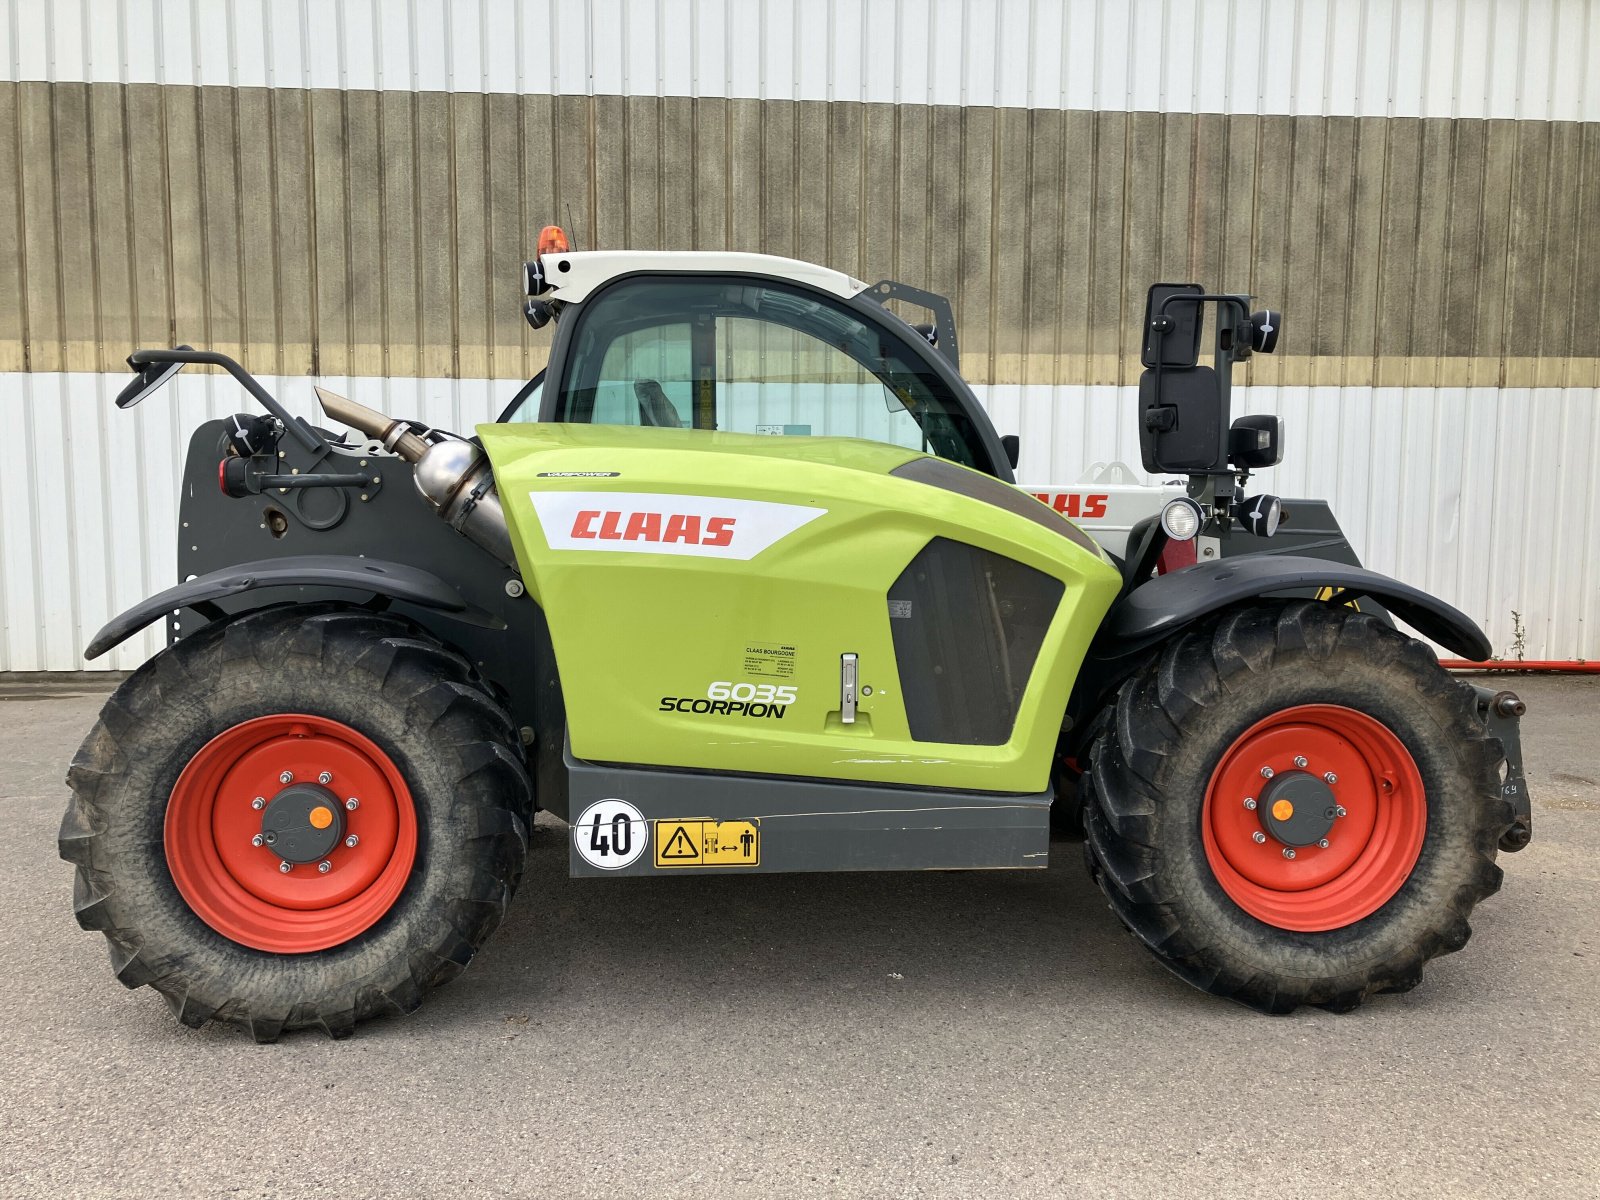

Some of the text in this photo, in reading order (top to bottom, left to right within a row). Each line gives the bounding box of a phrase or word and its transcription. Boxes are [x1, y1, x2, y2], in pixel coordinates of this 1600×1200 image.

[570, 510, 737, 547] CLAAS
[707, 681, 798, 704] 6035
[659, 697, 787, 719] SCORPION
[590, 813, 631, 856] 40
